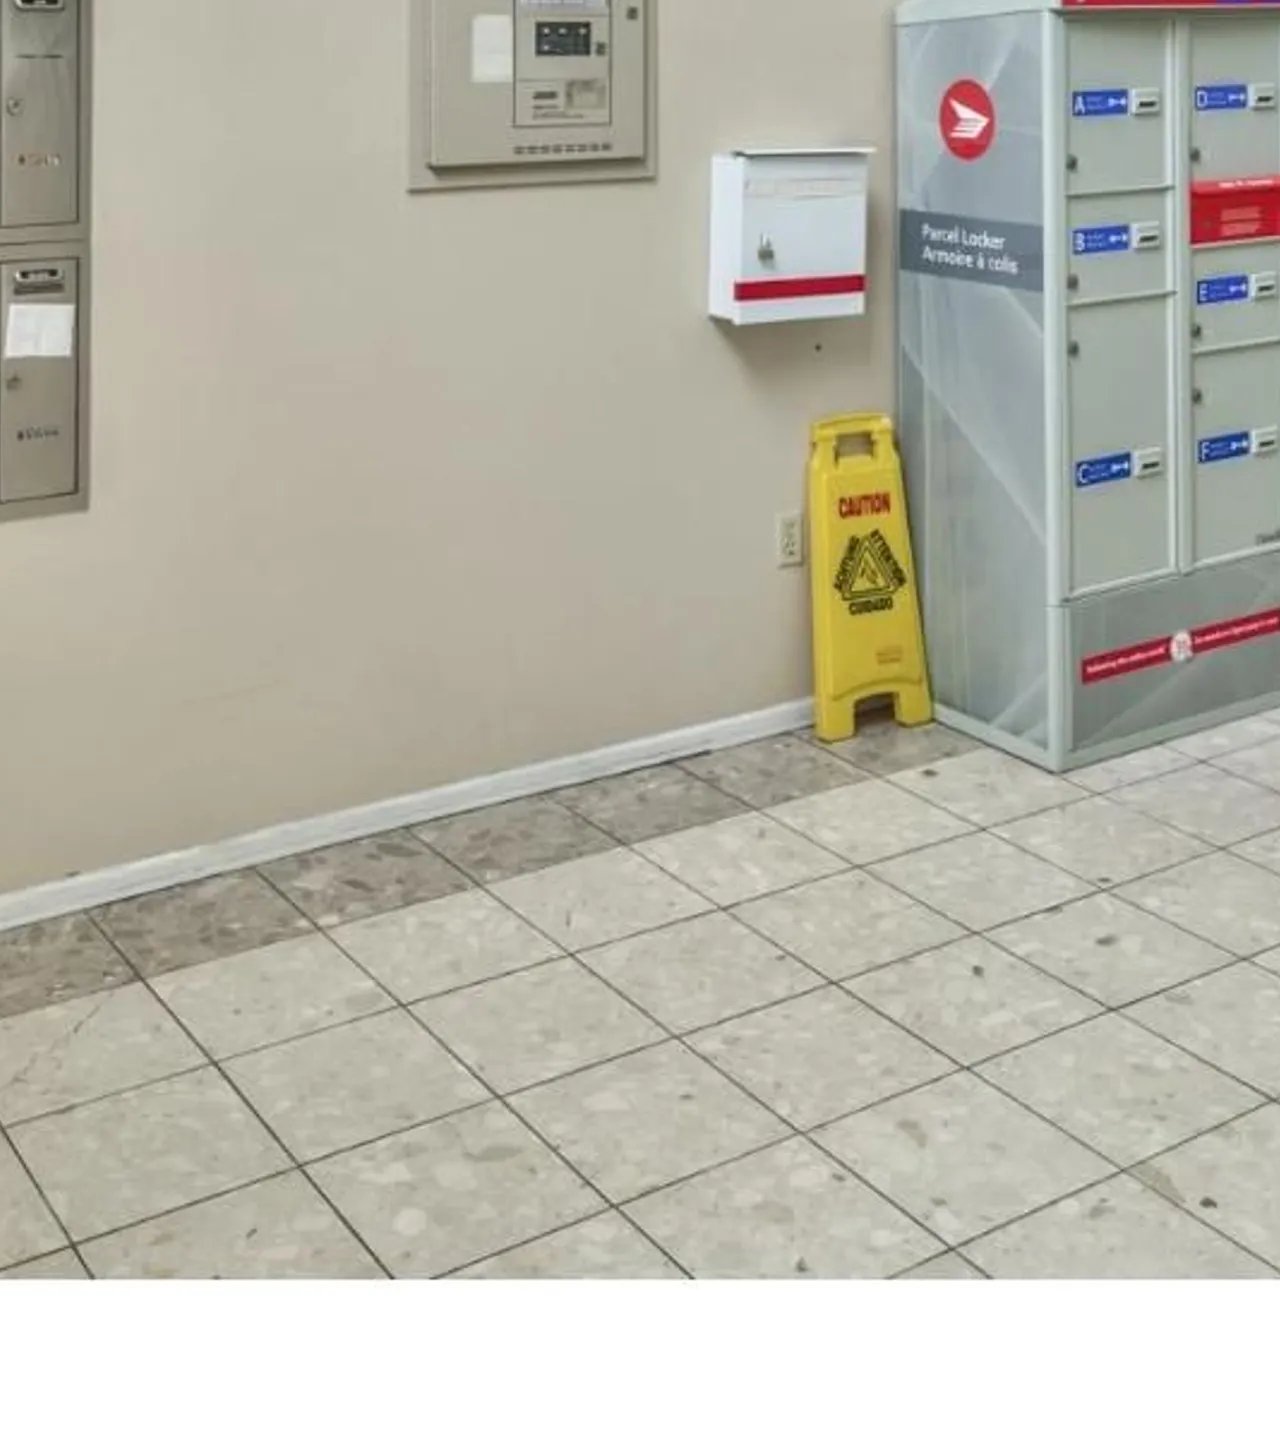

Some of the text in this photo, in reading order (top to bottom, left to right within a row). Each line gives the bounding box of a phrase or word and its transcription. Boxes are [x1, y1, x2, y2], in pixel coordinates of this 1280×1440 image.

[1075, 95, 1085, 114] A
[1196, 90, 1208, 108] D
[921, 223, 1006, 250] Parcel Locker
[1075, 233, 1085, 252] B
[922, 245, 974, 268] Armoire
[988, 254, 1019, 275] colis
[1199, 284, 1207, 301] E
[1202, 442, 1210, 460] F
[1078, 464, 1088, 483] C
[839, 492, 891, 519] CAUTION
